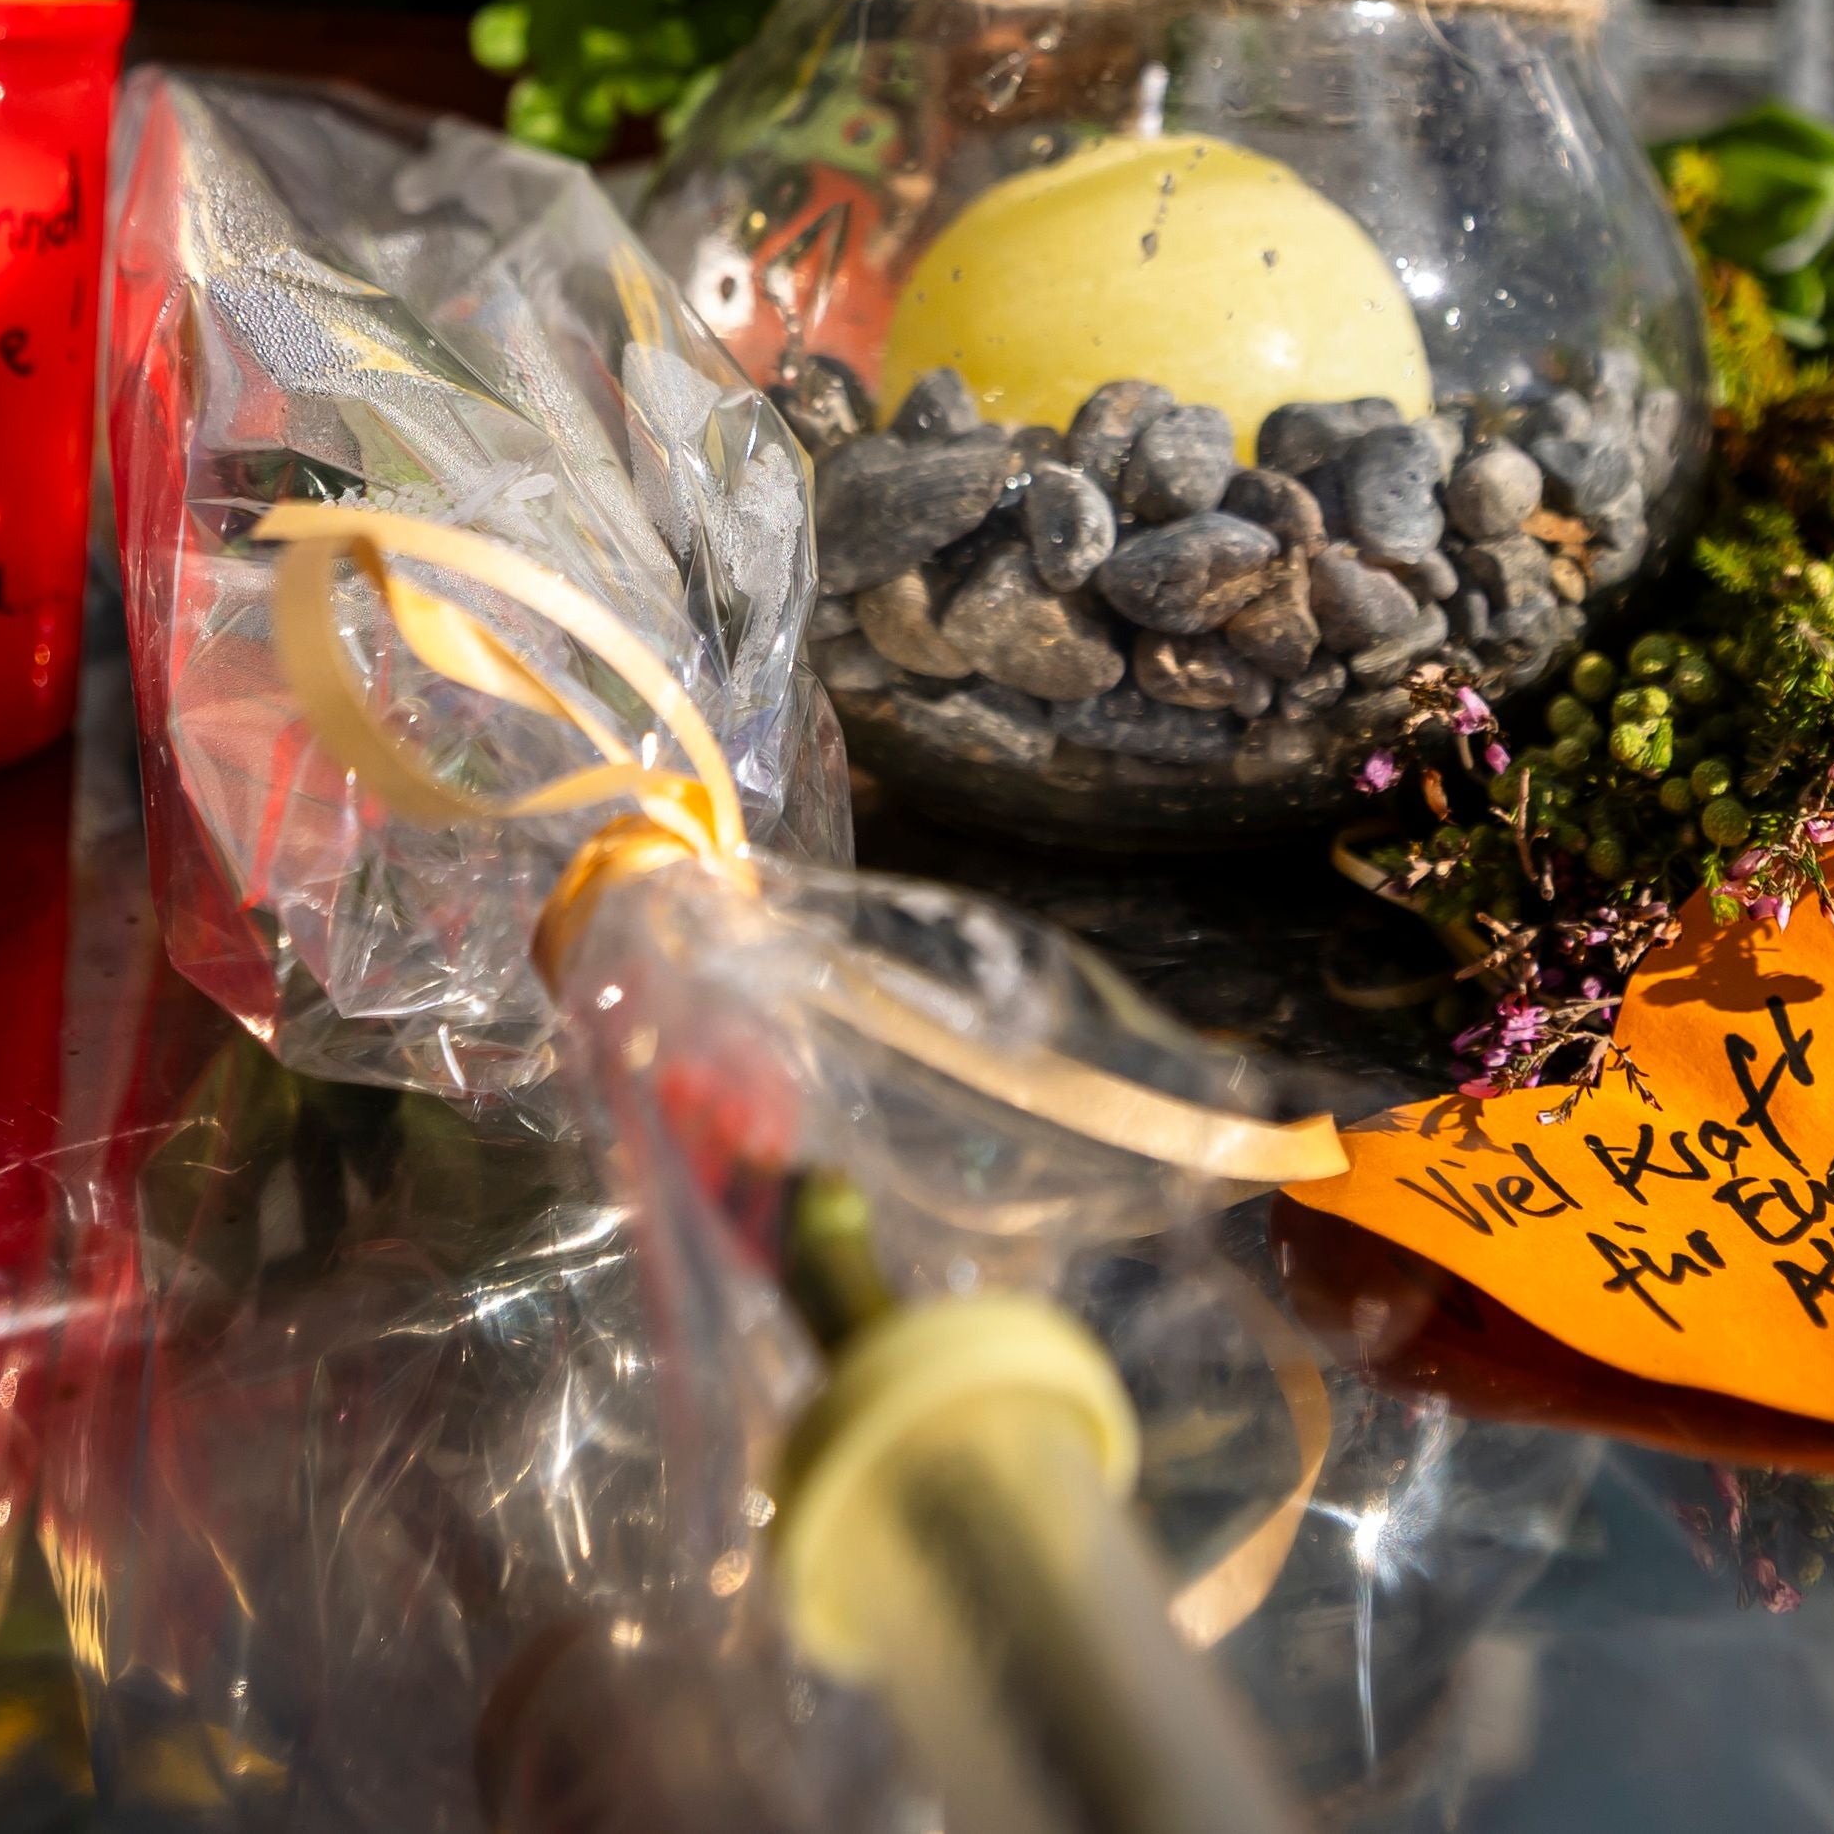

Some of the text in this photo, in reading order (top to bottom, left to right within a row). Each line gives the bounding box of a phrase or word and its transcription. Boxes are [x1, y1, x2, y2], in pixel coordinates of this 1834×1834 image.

[1394, 995, 1815, 1237] Viel Kraft
[1585, 1220, 1727, 1333] für
